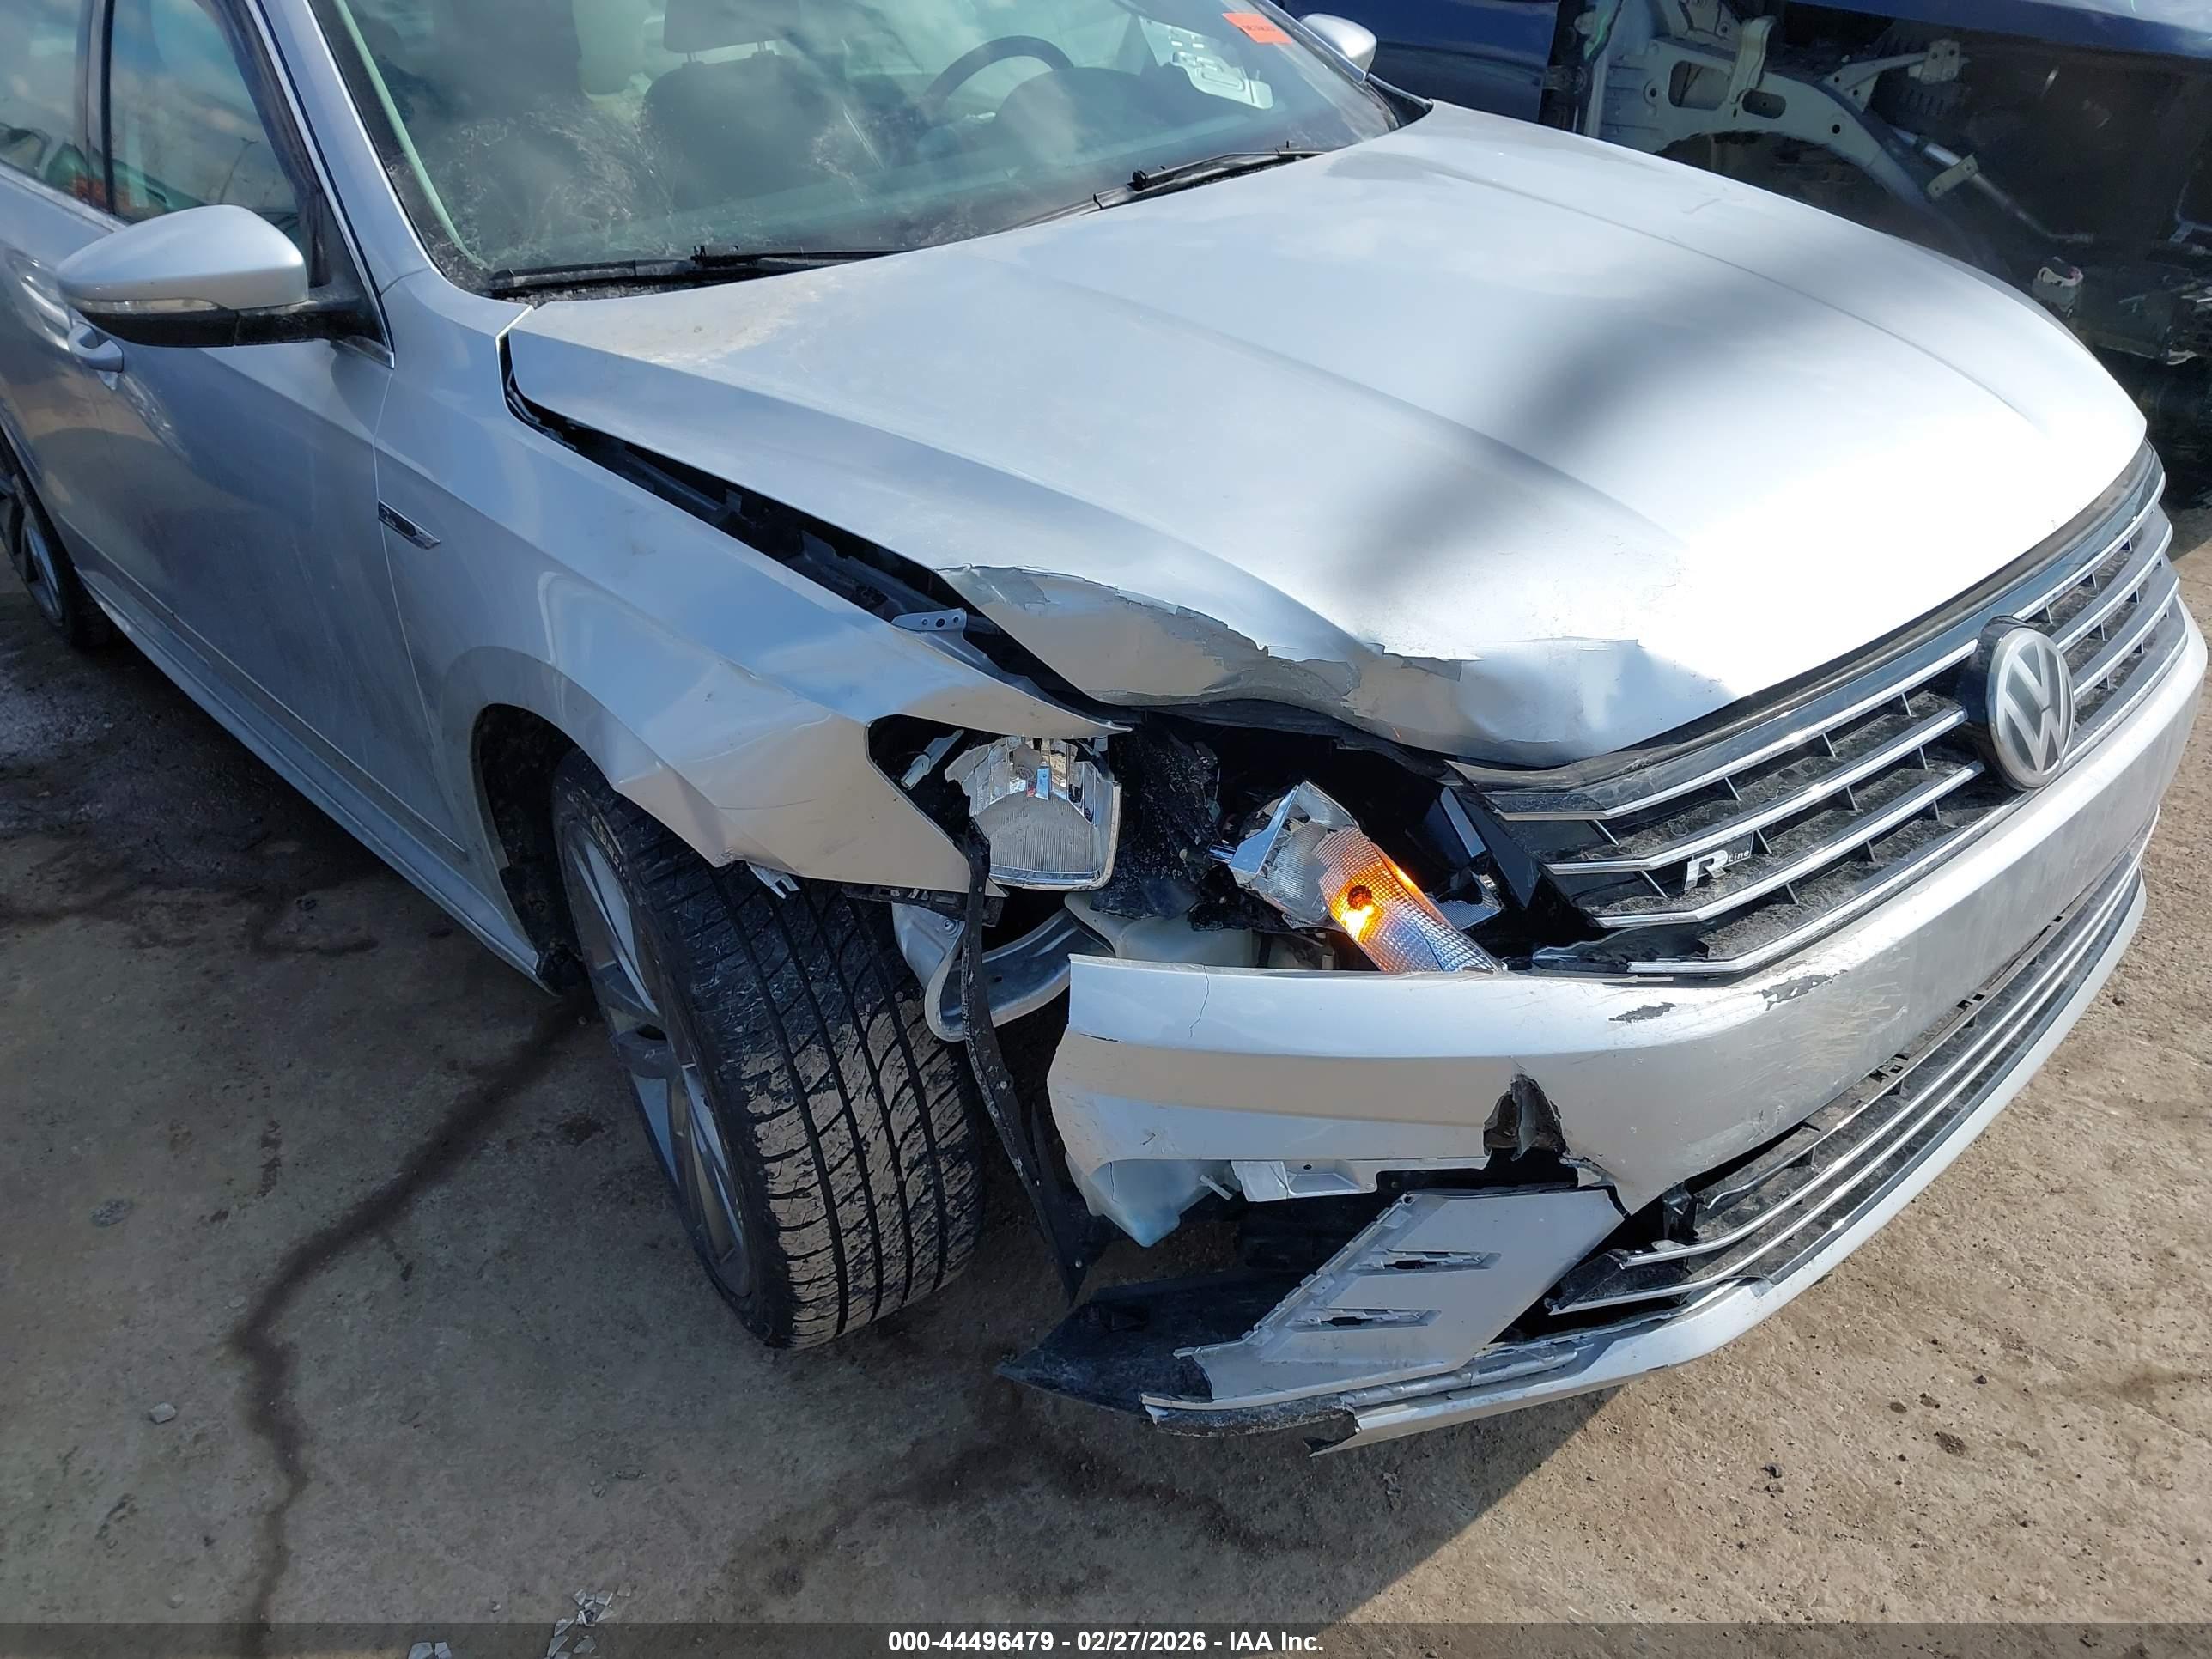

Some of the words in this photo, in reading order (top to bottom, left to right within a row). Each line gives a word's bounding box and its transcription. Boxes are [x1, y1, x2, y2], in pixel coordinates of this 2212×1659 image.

[1995, 634, 2072, 781] VW
[1684, 850, 1729, 891] R
[1729, 850, 1750, 862] Line
